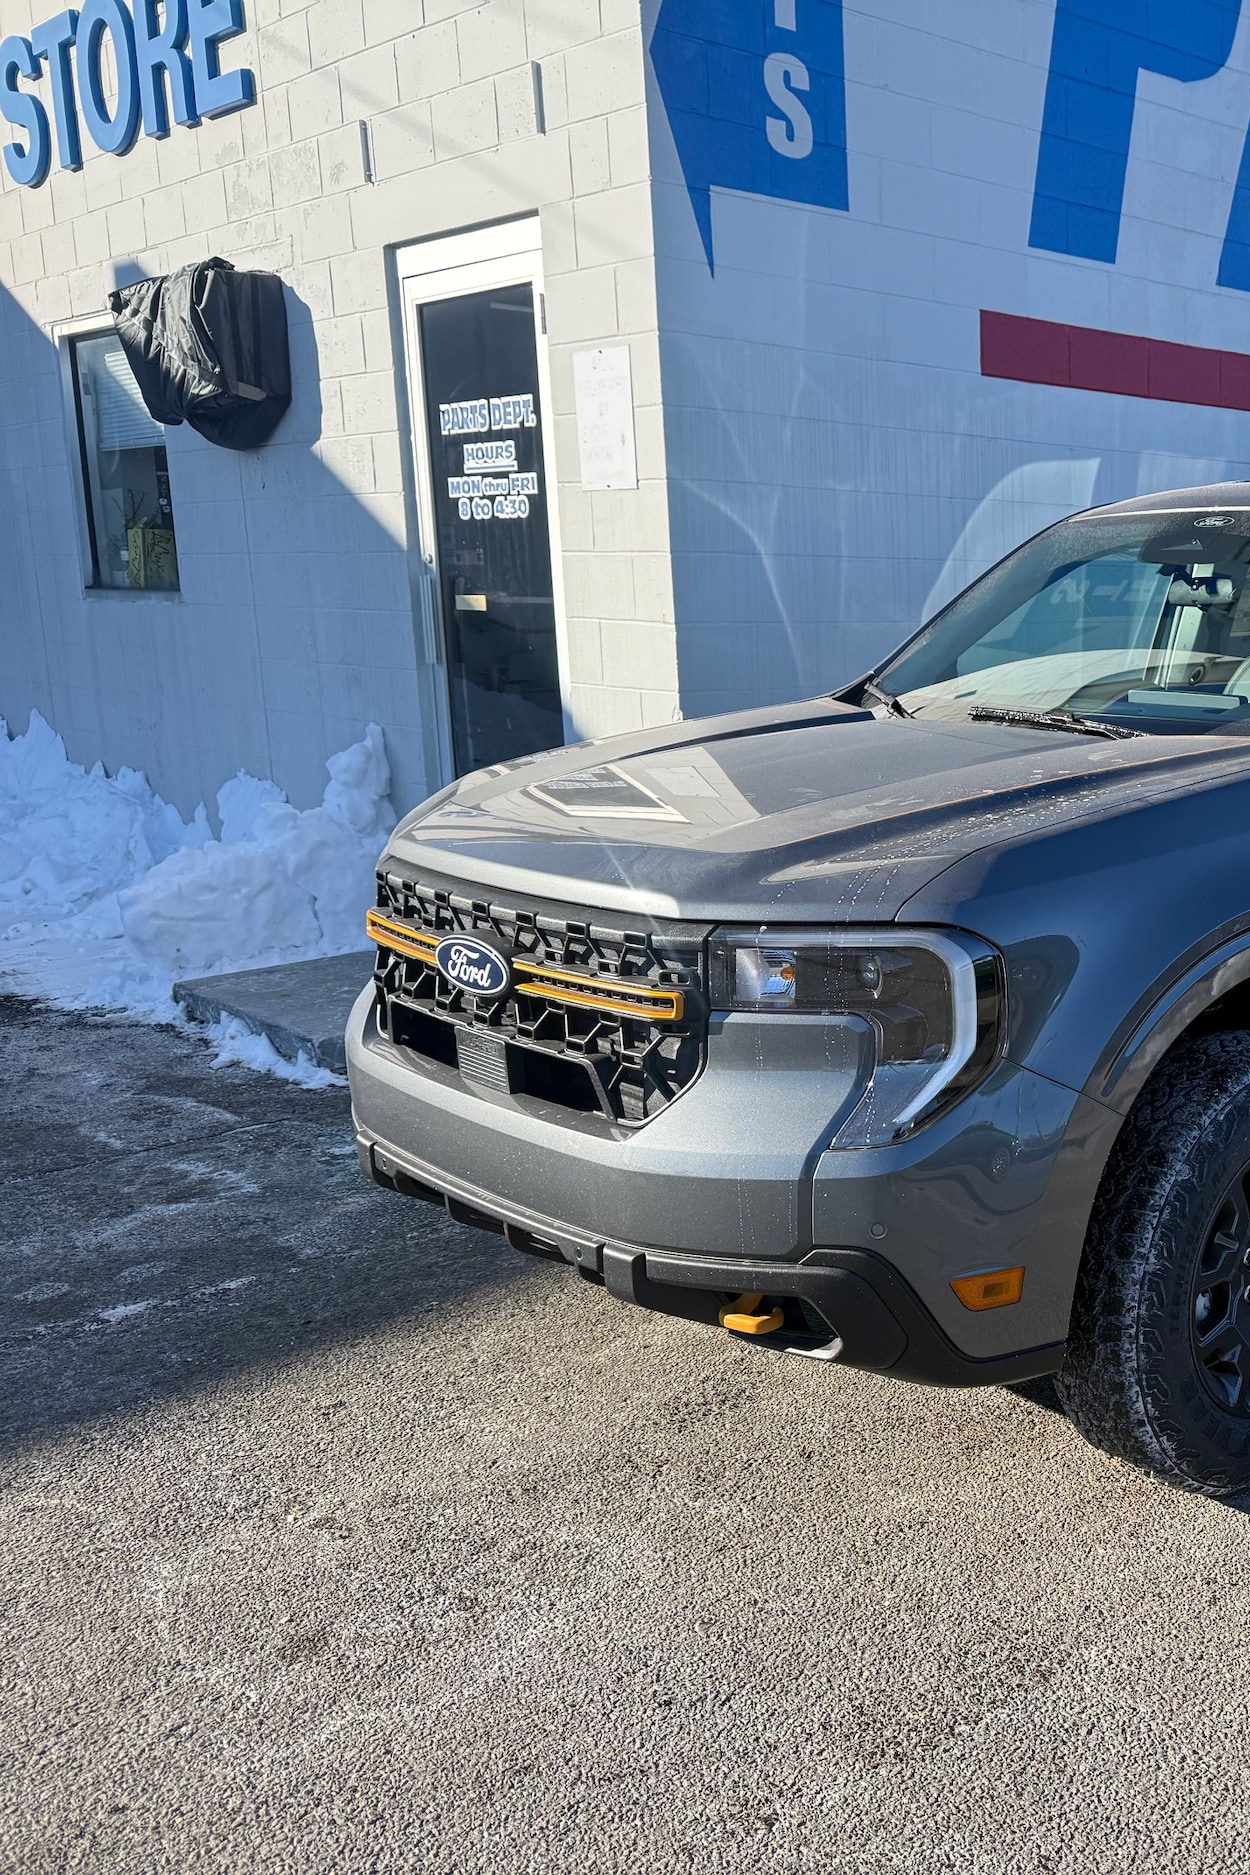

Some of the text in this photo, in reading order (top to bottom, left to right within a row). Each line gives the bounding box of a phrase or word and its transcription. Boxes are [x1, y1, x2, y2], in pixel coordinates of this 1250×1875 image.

[0, 0, 257, 188] STORE
[440, 393, 537, 435] PARTS DEPT.
[463, 440, 516, 463] HOURS
[448, 472, 538, 498] MON thru FRI
[458, 495, 529, 520] 8 to 4:30
[448, 945, 491, 987] Ford
